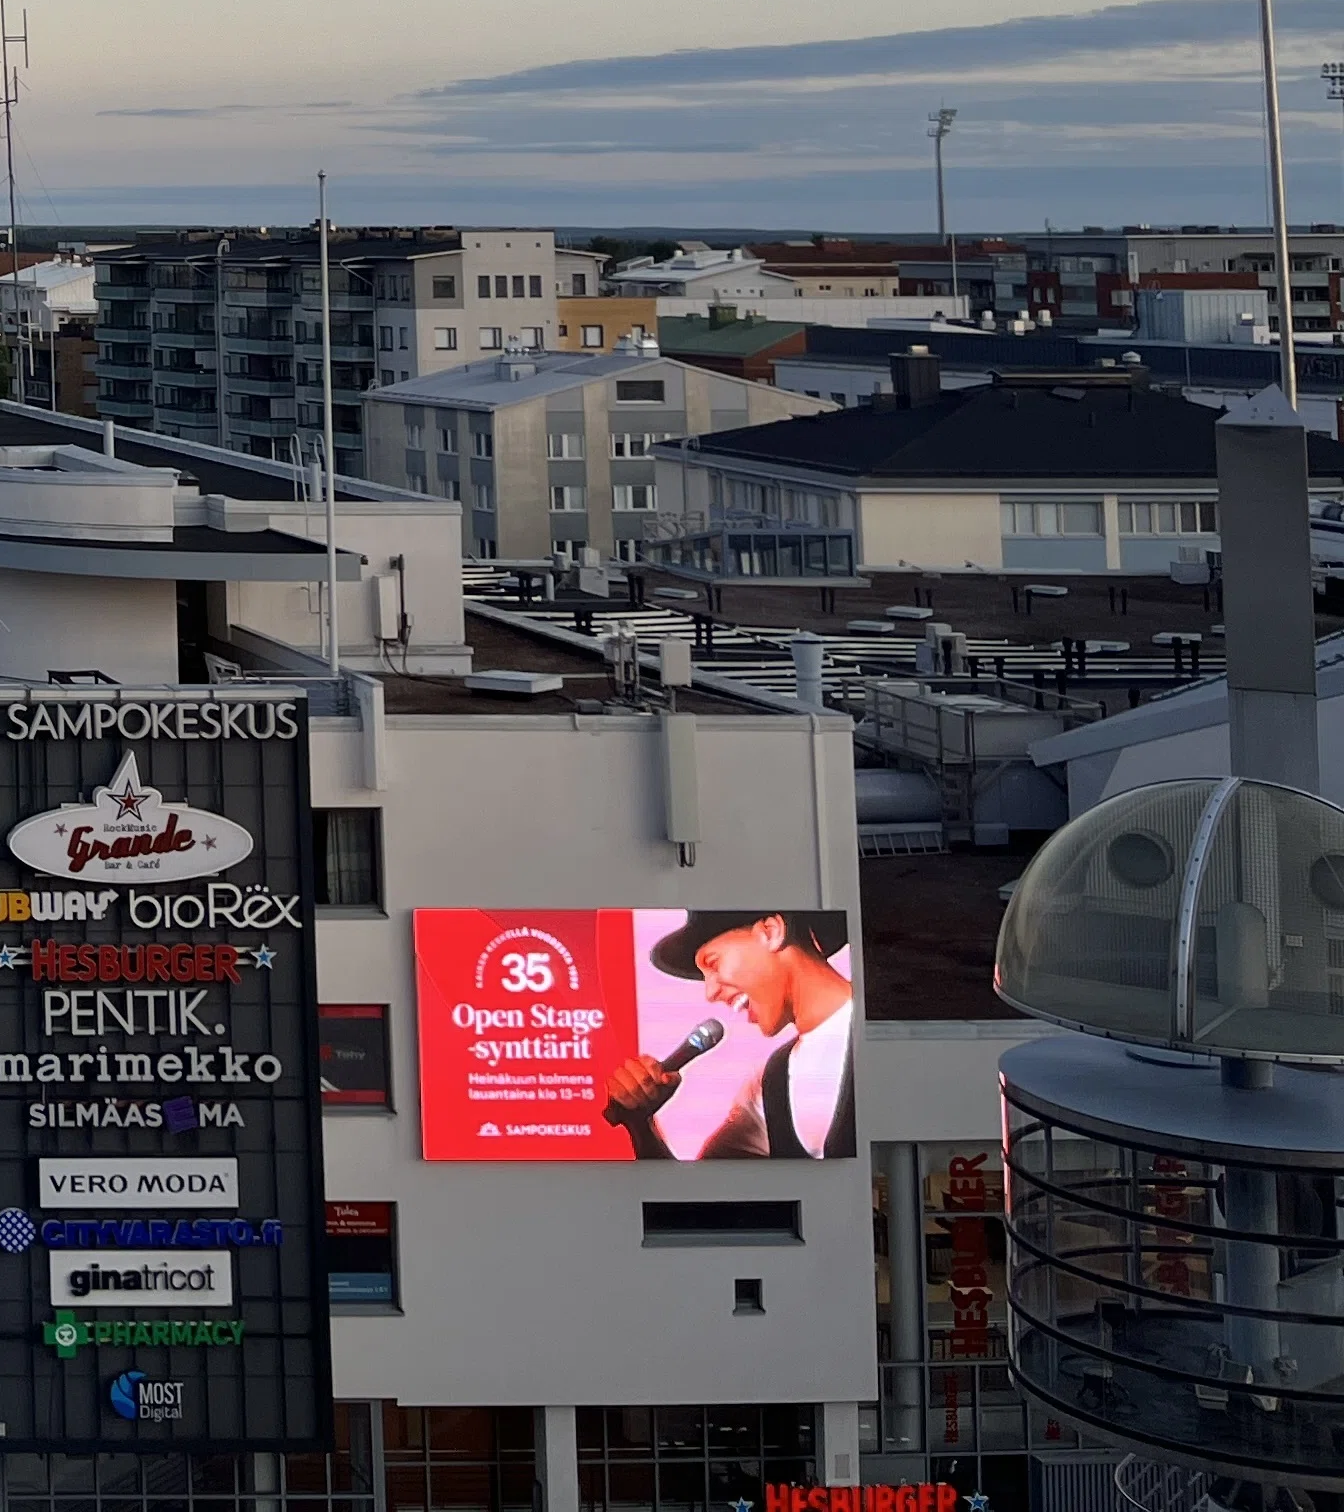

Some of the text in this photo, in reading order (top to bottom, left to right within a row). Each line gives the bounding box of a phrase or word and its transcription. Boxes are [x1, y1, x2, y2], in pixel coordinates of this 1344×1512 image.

[6, 702, 299, 741] SAMPOKESKUS
[103, 823, 158, 833] RockMusic
[66, 813, 197, 874] Grande
[31, 939, 242, 984] HESBURGER
[500, 952, 554, 993] 35
[452, 1003, 605, 1035] Open Stage
[467, 1034, 592, 1067] -synttärit
[537, 1088, 558, 1100] klo
[505, 1124, 591, 1136] SAMPOKESKUS
[49, 1173, 226, 1193] VERO MODA
[40, 1219, 284, 1247] CITYVARASTO.fi
[69, 1262, 215, 1297] ginatricot
[94, 1320, 246, 1348] PHARMACY
[139, 1382, 184, 1406] MOST
[139, 1404, 183, 1423] Digital
[765, 1483, 959, 1512] HESBURGER
